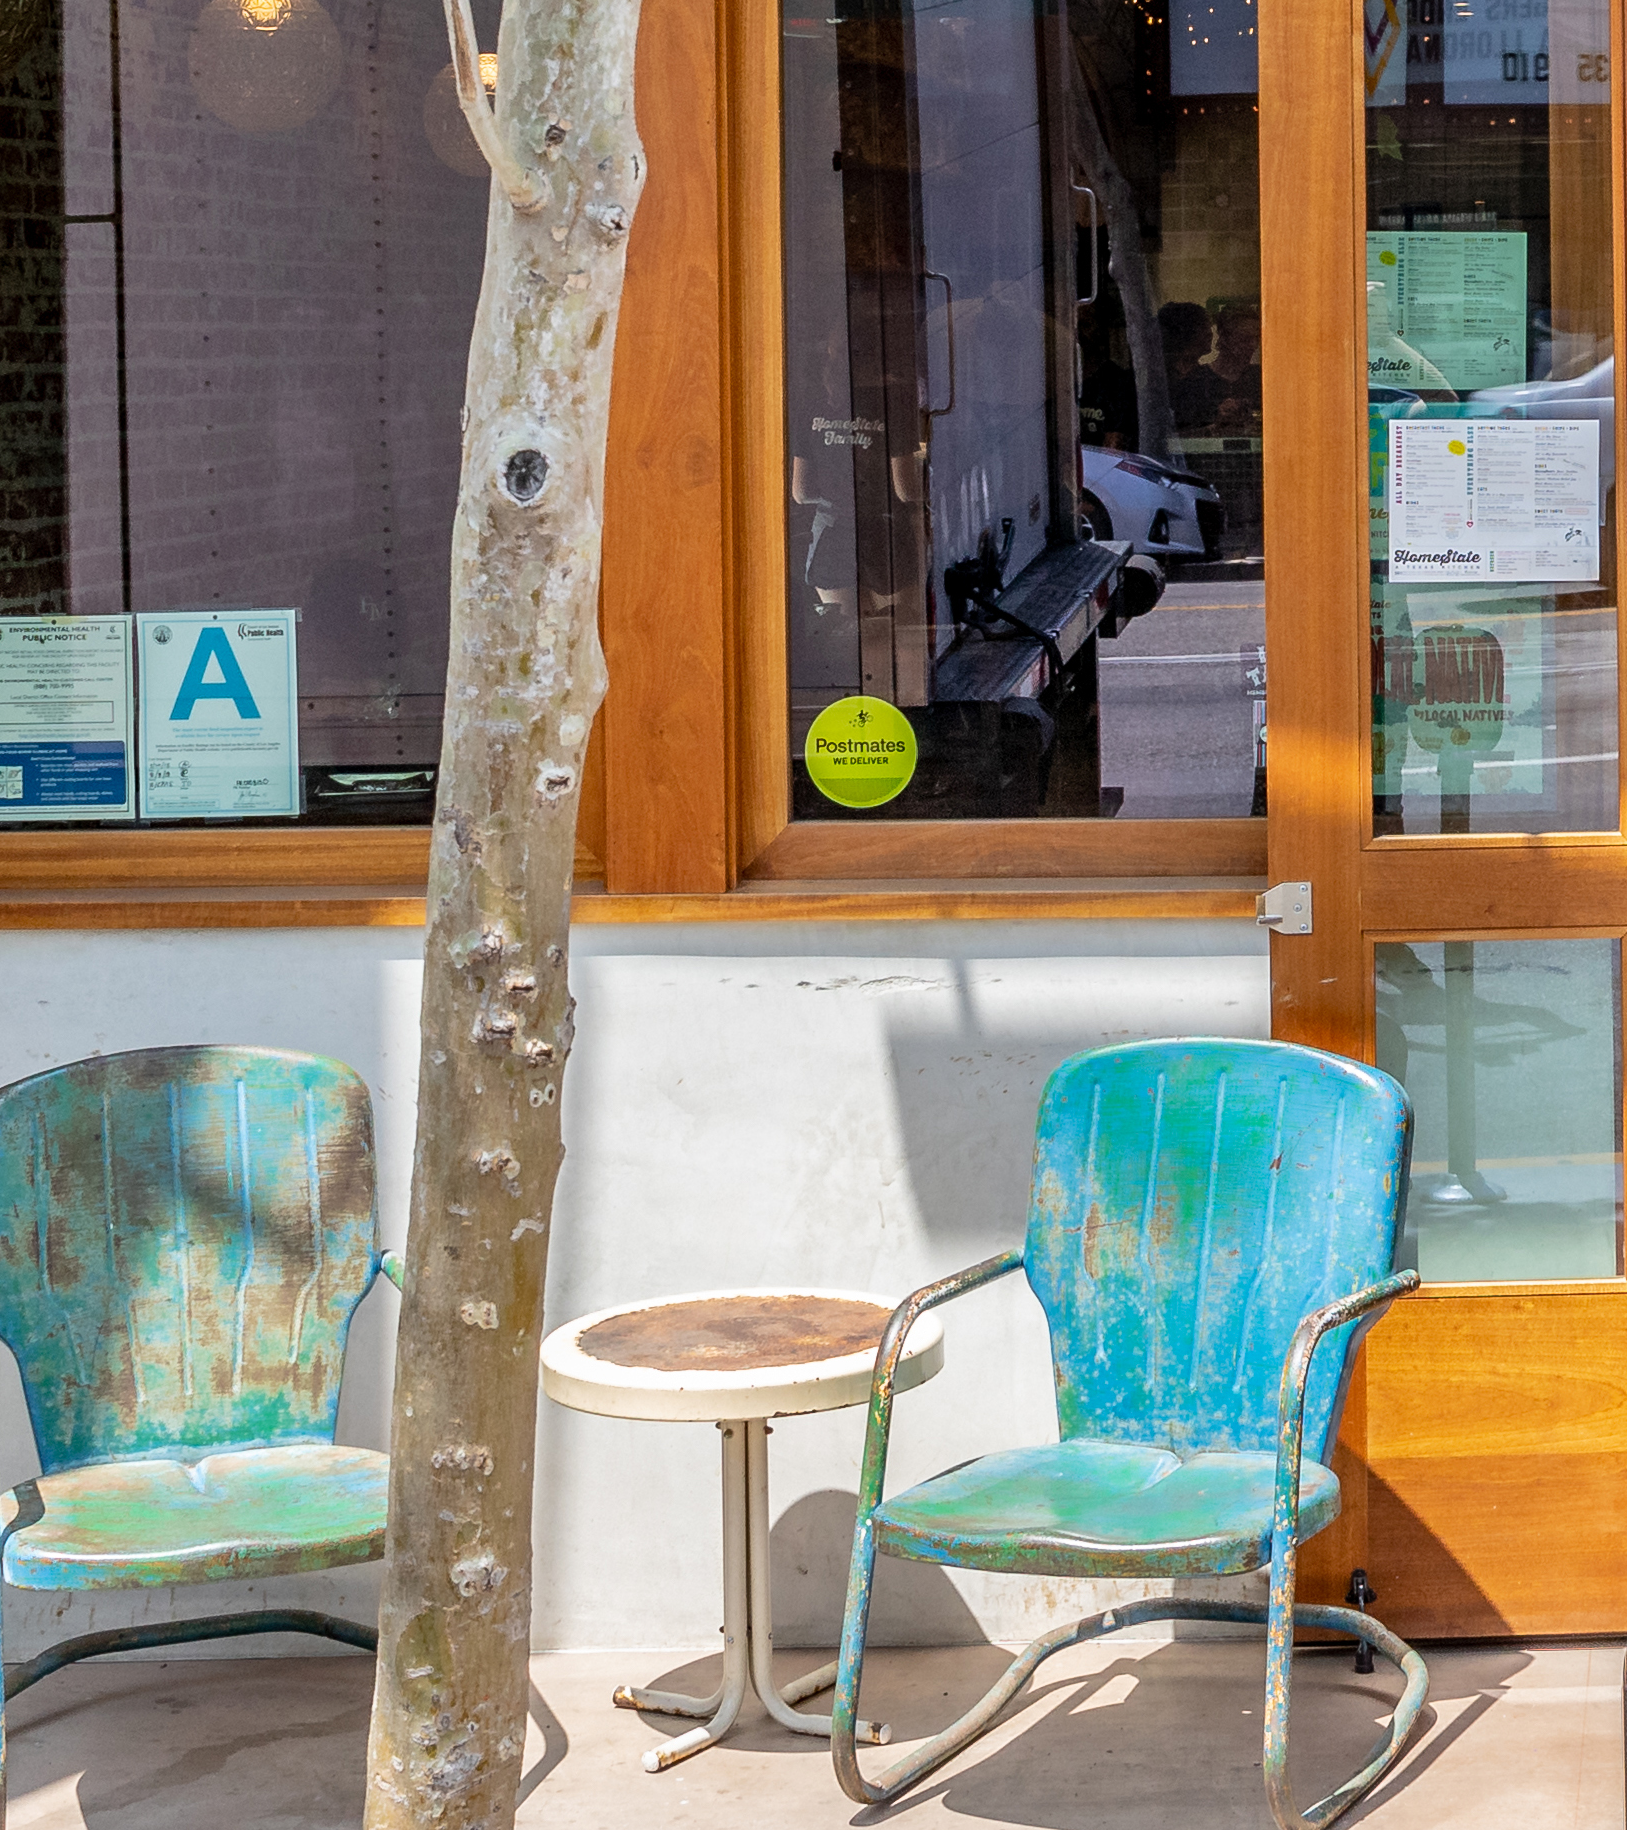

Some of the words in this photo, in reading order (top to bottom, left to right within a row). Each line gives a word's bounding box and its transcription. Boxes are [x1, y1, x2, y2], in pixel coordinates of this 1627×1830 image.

[1394, 549, 1482, 566] HomeState
[169, 627, 261, 720] A
[816, 738, 906, 753] Postmates
[833, 757, 848, 766] WE
[850, 756, 889, 765] DELIVER
